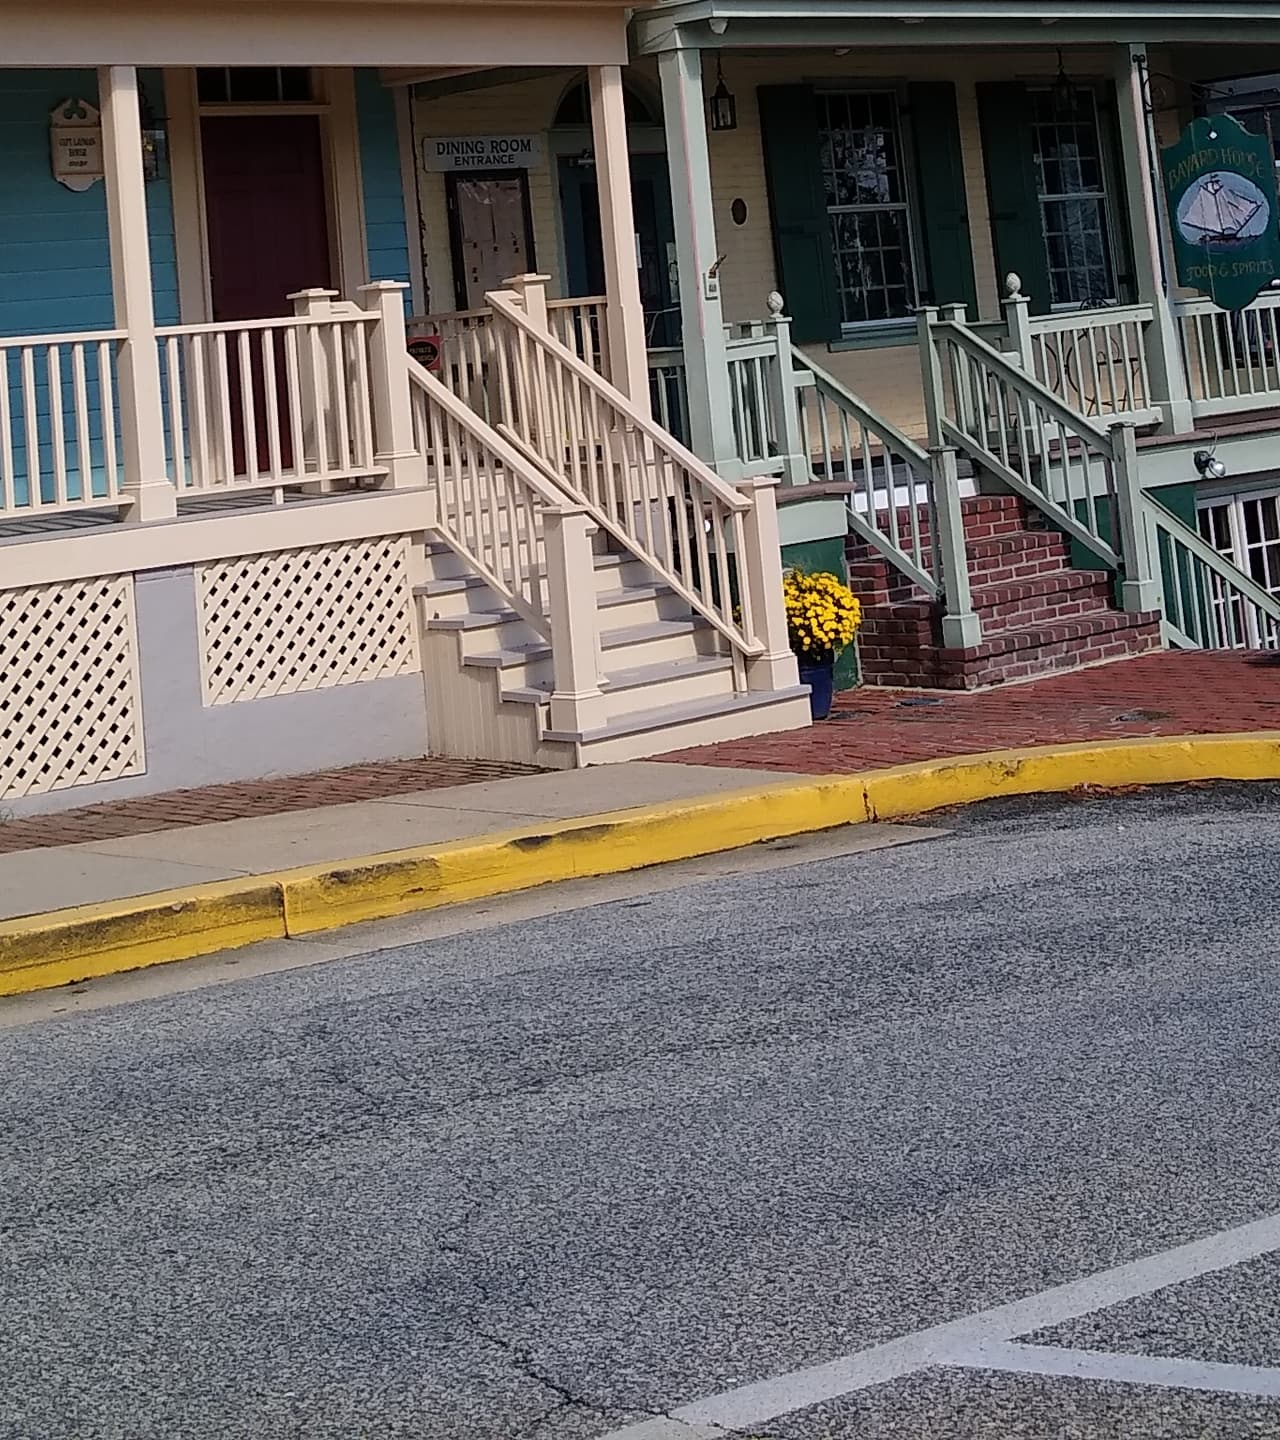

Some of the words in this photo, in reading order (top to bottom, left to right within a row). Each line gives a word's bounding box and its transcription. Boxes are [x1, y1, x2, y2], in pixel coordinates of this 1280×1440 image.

[436, 140, 484, 155] DINING
[490, 139, 531, 154] ROOM
[454, 154, 515, 166] ENTRANCE
[1168, 149, 1218, 191] BAYARD
[1221, 148, 1265, 179] HOUSE
[1231, 260, 1275, 277] SPIRITS
